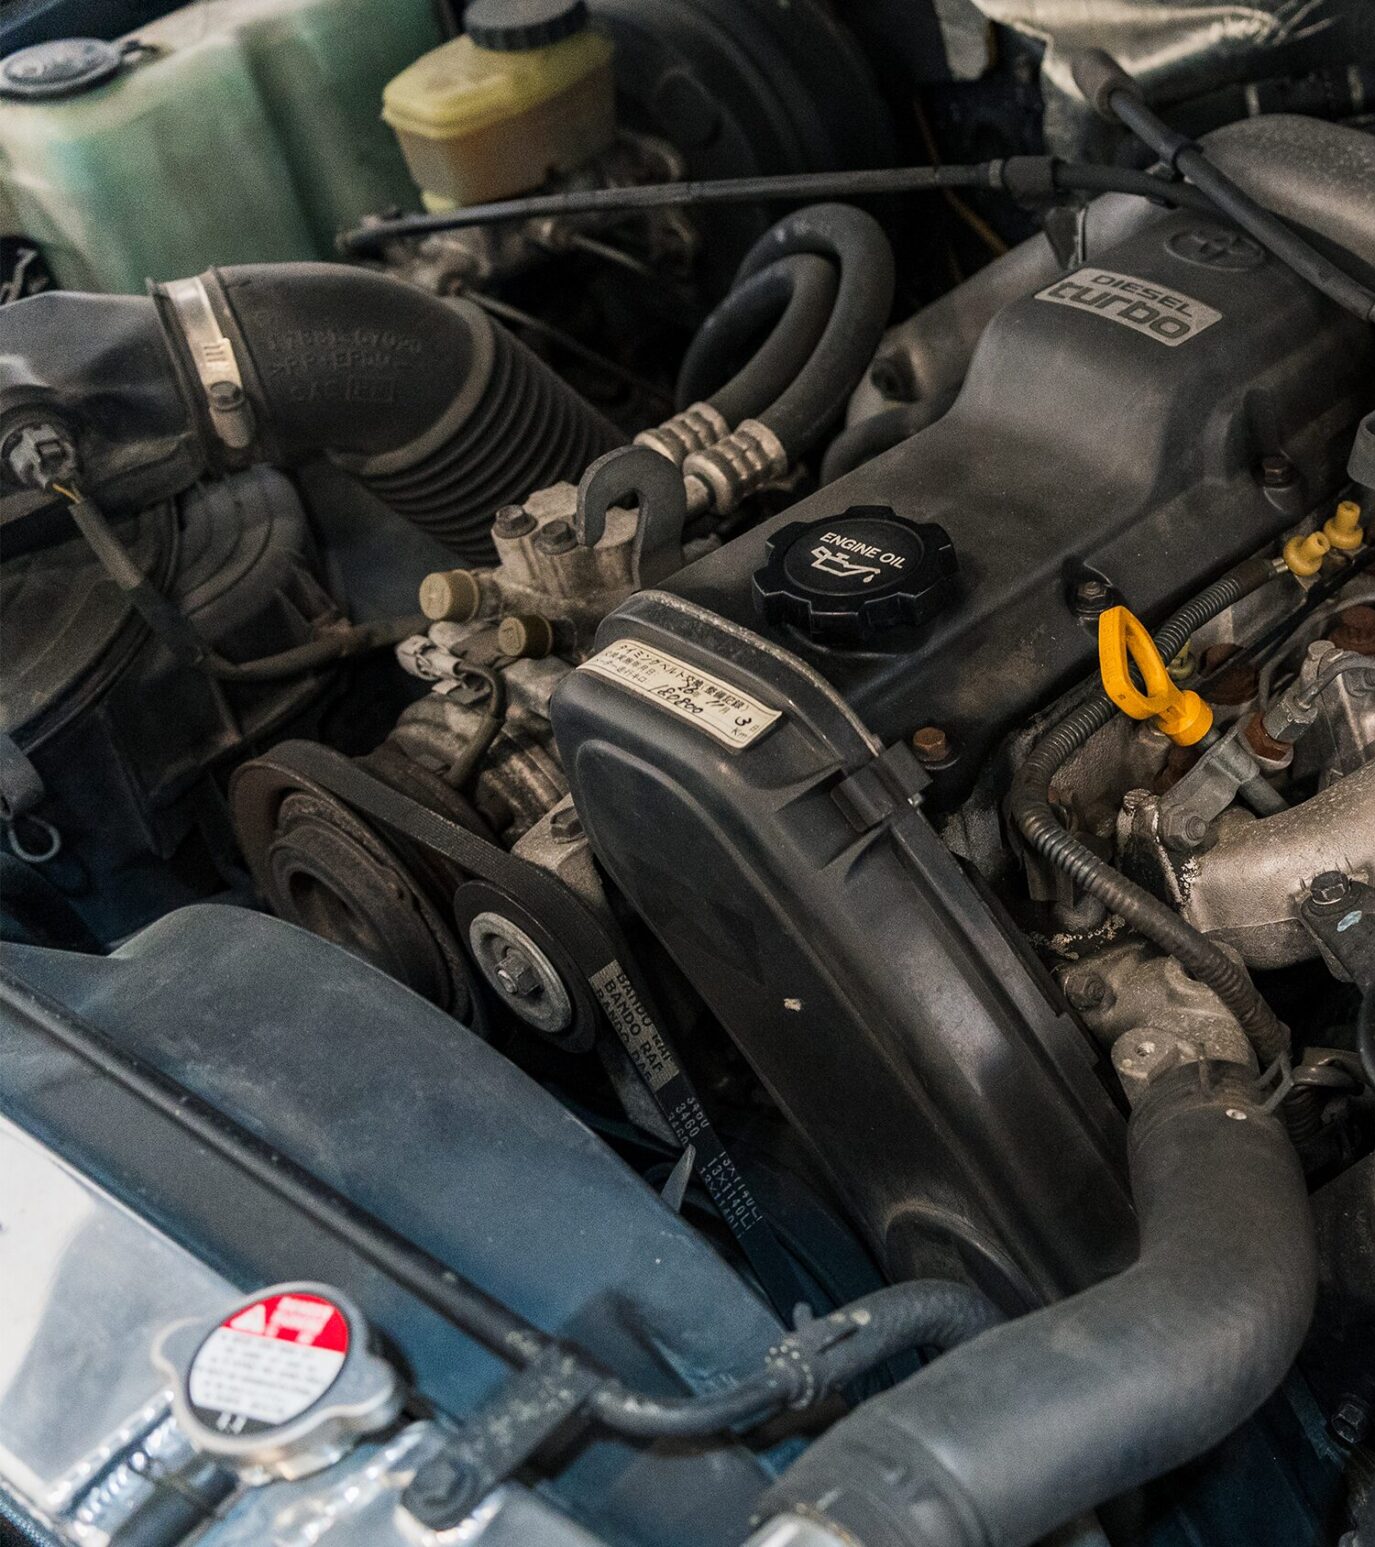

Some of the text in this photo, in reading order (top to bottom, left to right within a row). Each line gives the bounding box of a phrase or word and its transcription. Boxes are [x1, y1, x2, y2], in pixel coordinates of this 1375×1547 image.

[1047, 281, 1192, 339] turbo
[1091, 275, 1193, 318] DIESEL
[819, 532, 906, 569] ENGINE OIL
[604, 979, 641, 1036] BANDO
[675, 1102, 701, 1138] 3460
